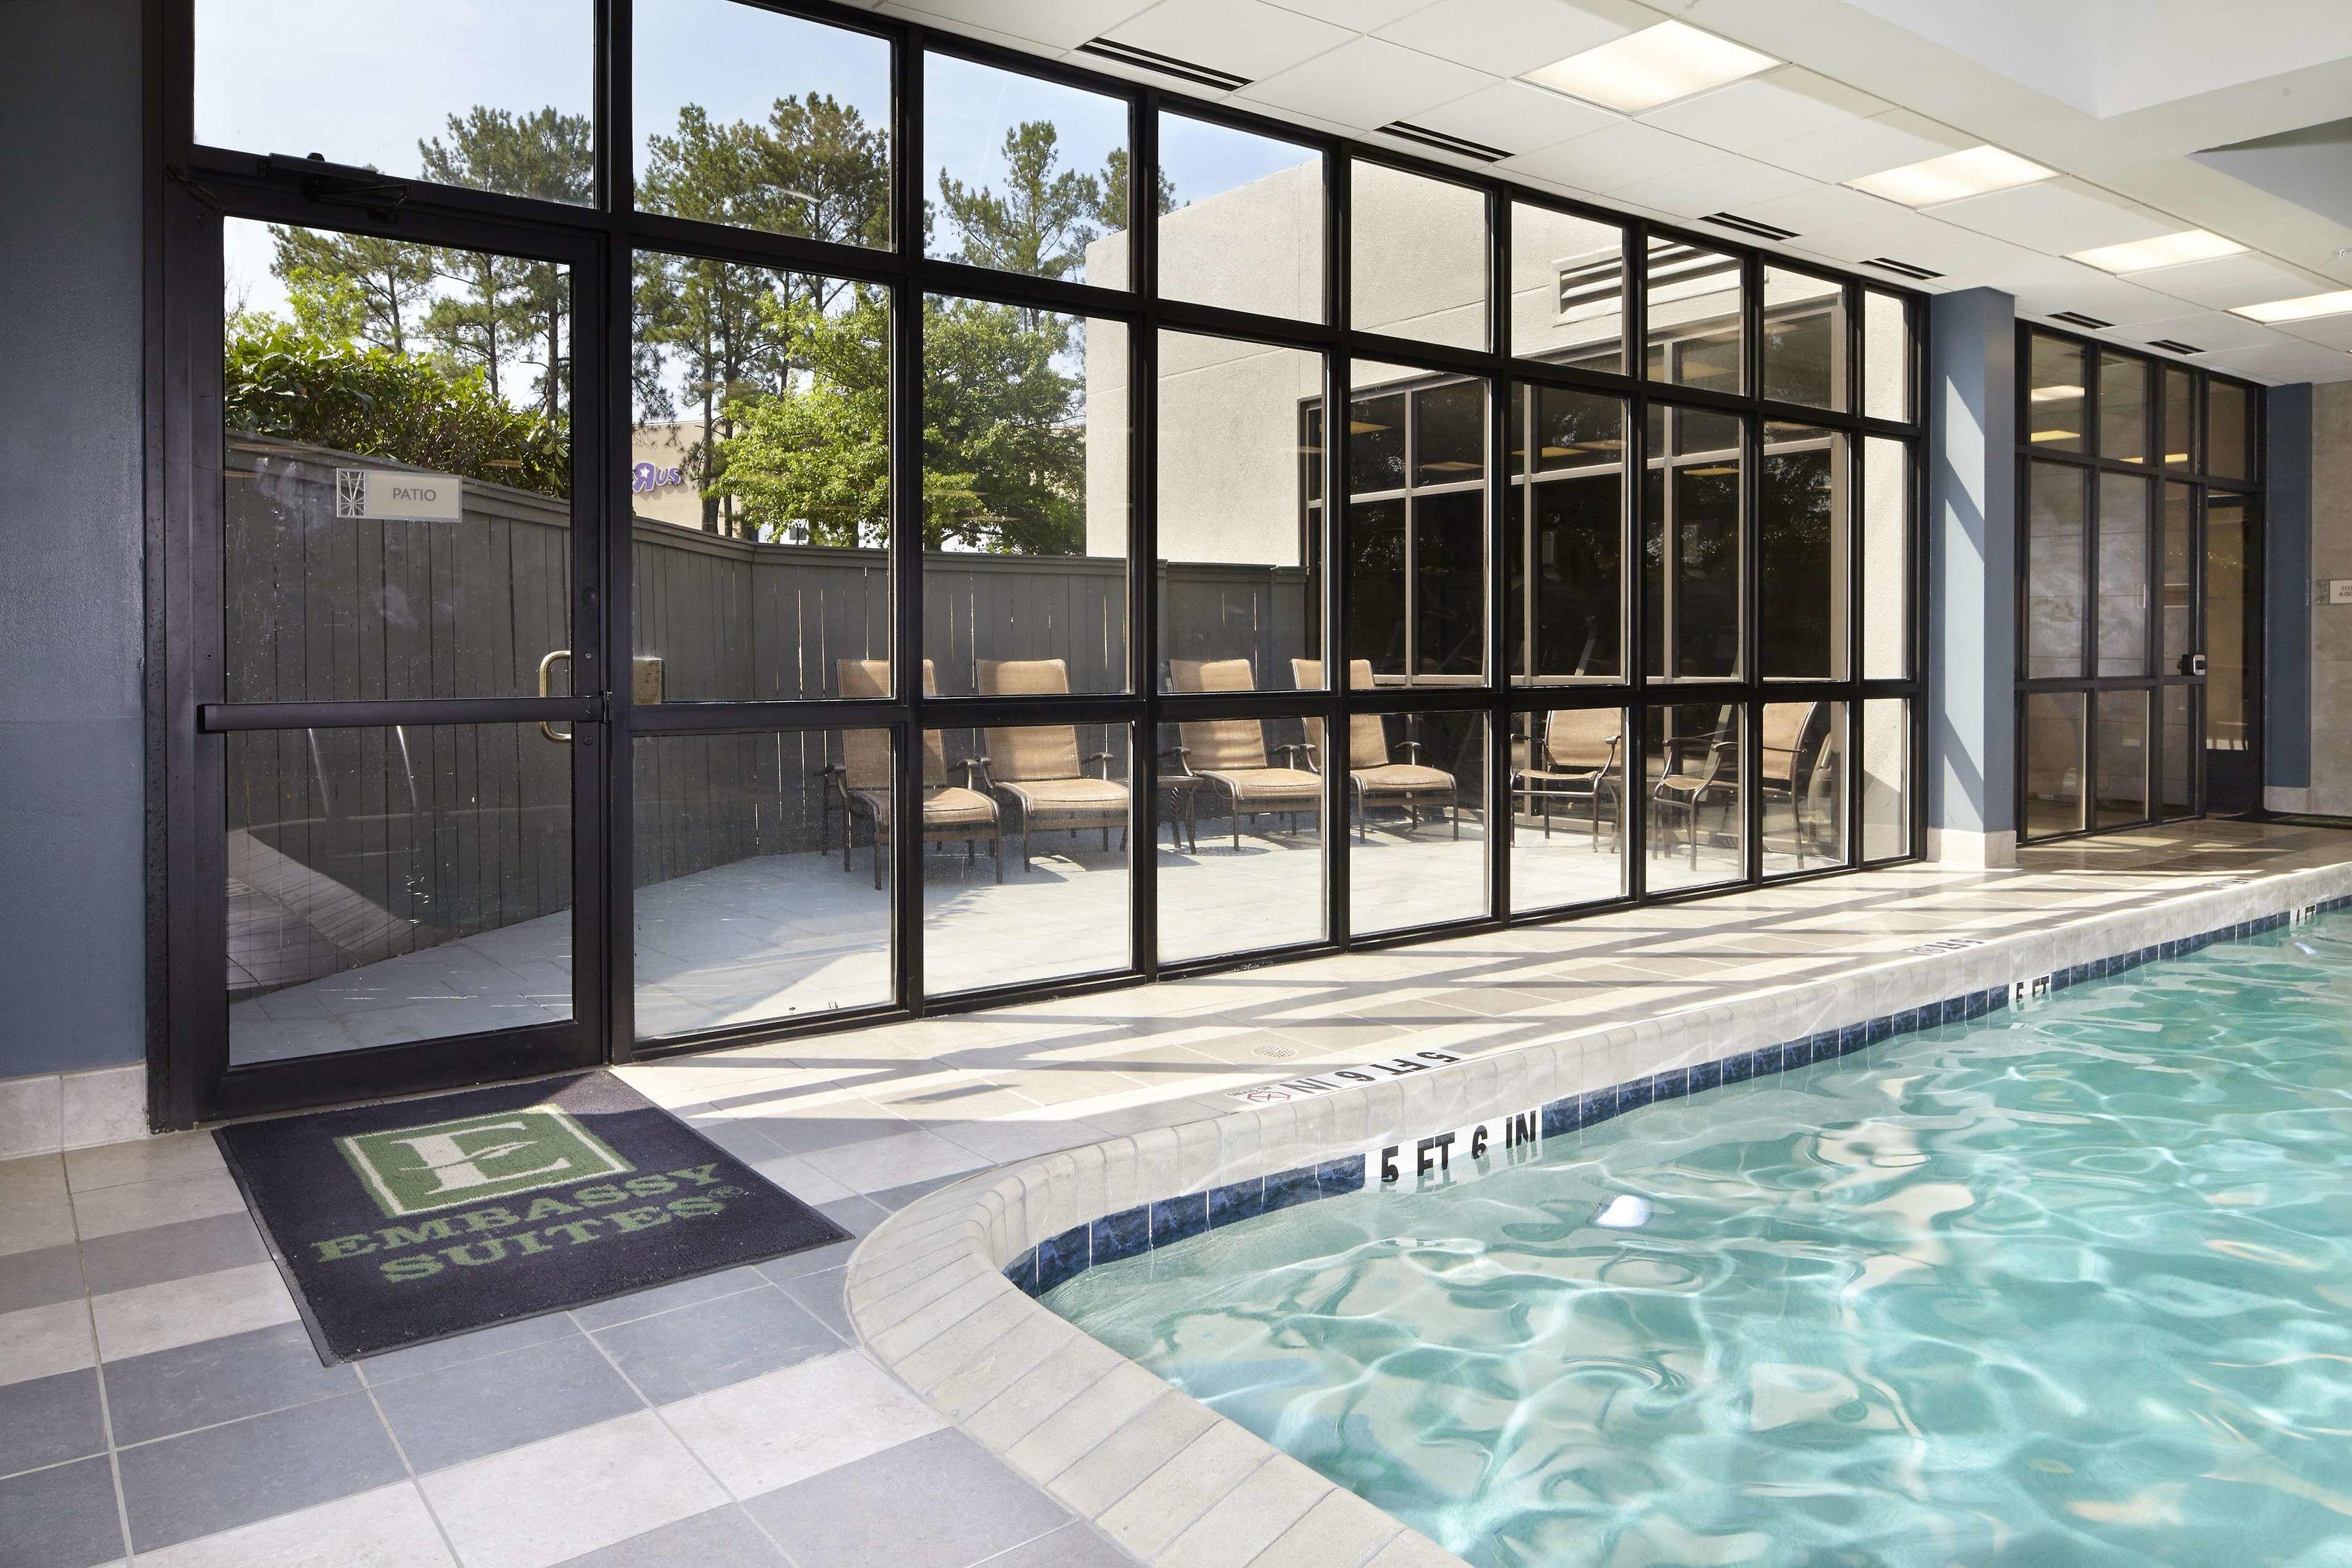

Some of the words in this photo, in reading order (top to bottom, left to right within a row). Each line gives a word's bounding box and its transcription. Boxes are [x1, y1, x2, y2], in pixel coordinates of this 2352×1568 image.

[392, 487, 436, 502] PATIO
[2032, 976, 2050, 997] FT
[1417, 1051, 1460, 1063] 5
[1335, 1071, 1376, 1082] 6
[1370, 1058, 1431, 1076] FT
[1279, 1078, 1338, 1094] IN
[1381, 1146, 1399, 1183] 5
[1417, 1131, 1456, 1177] FT
[1472, 1124, 1488, 1159] 6
[1506, 1110, 1537, 1148] IN
[390, 1121, 570, 1194] E
[312, 1164, 721, 1263] EMBASSY
[379, 1196, 724, 1283] SUITES
